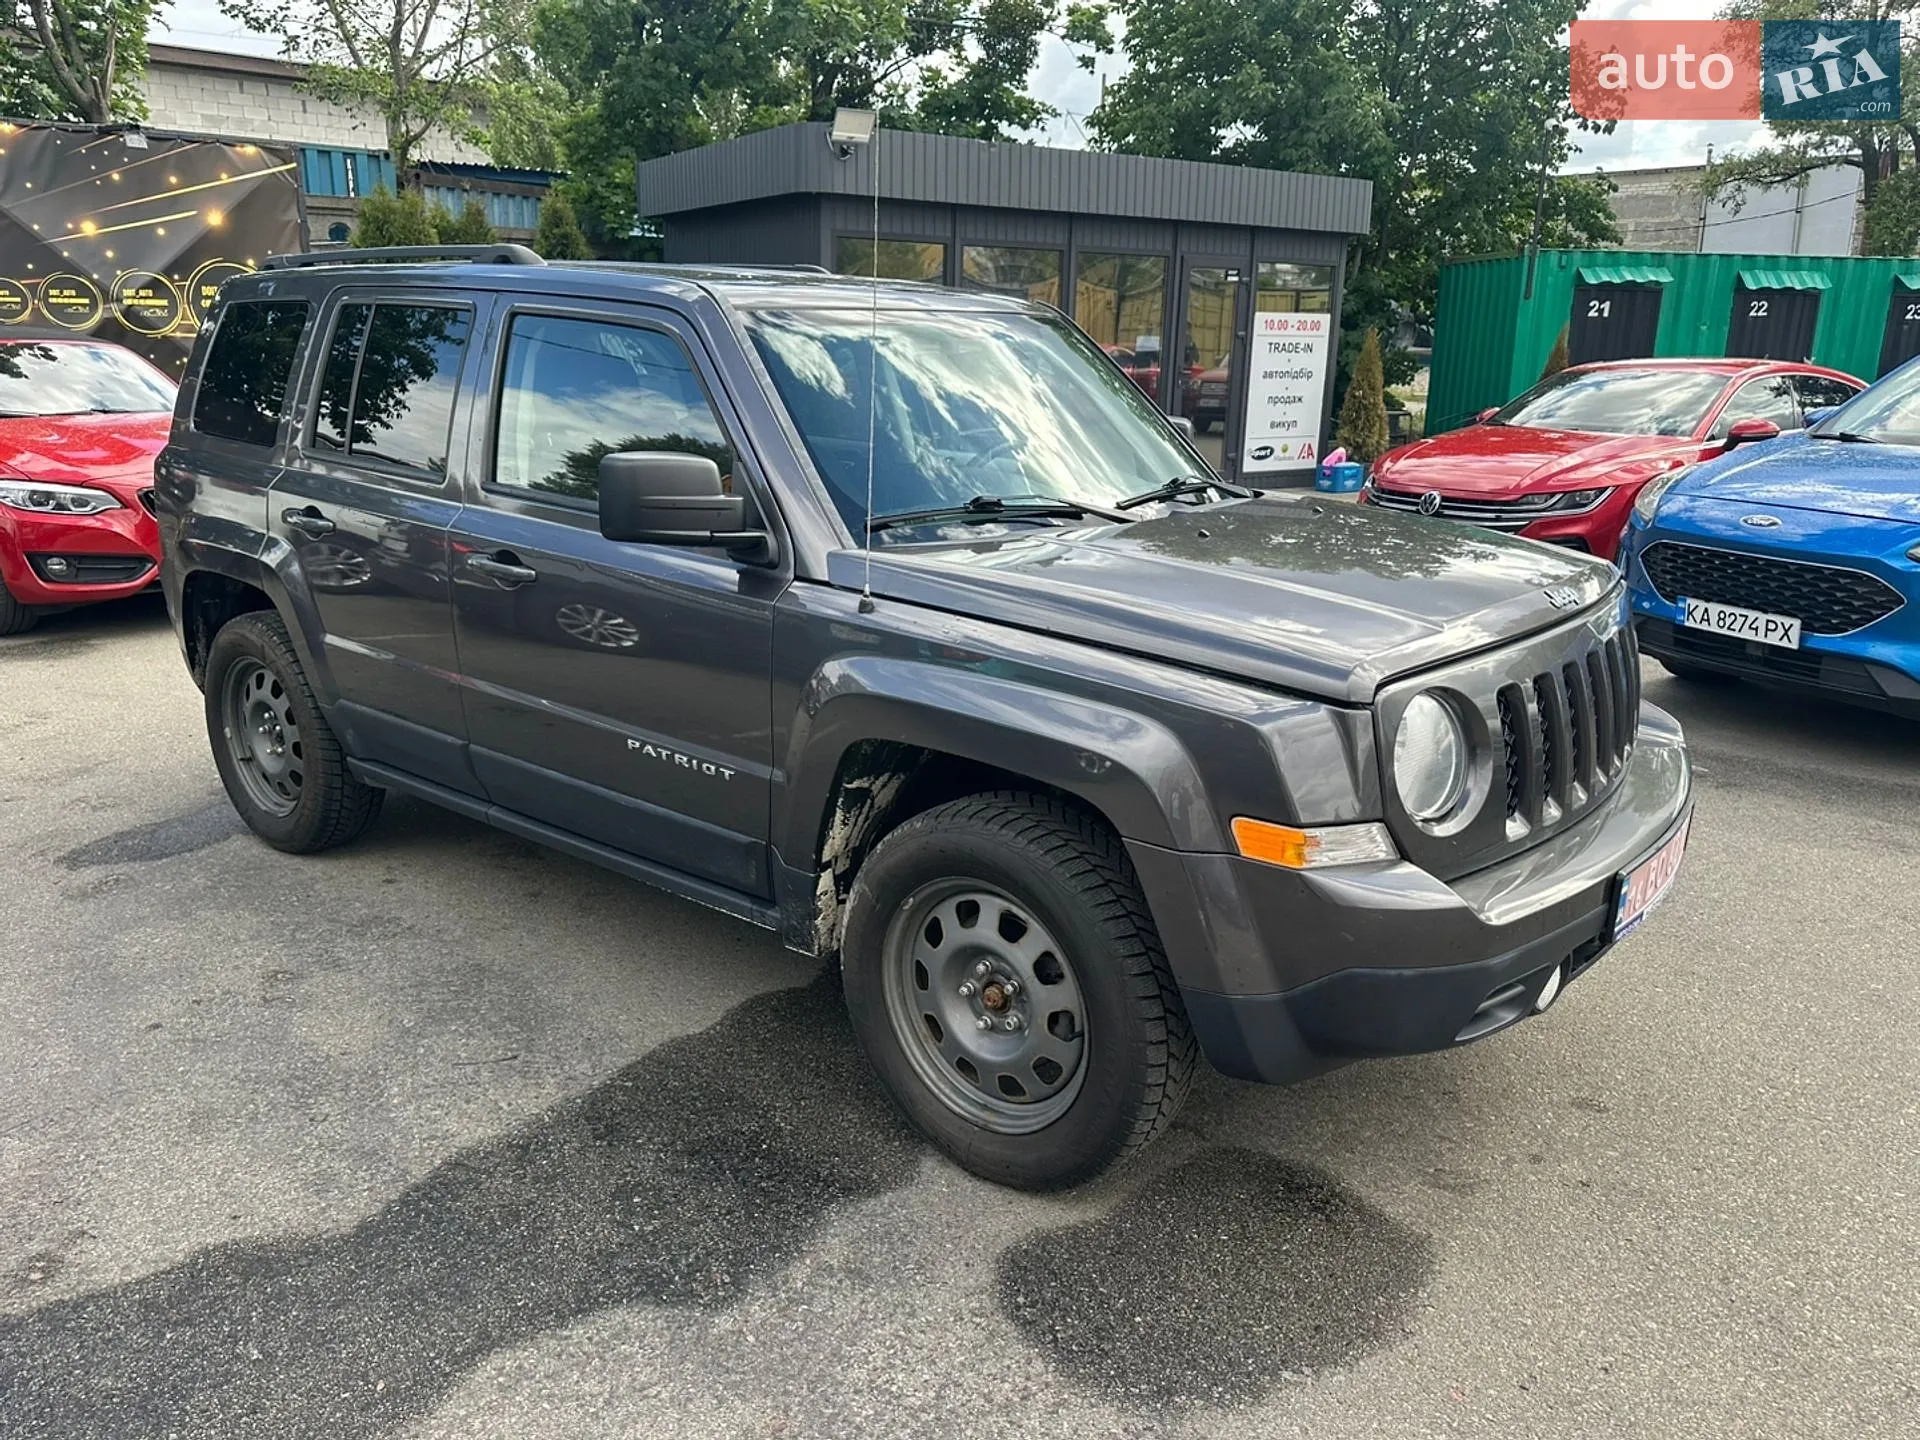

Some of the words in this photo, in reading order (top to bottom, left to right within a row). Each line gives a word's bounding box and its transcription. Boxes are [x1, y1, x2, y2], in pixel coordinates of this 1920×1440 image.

[1588, 300, 1612, 318] 21
[1749, 301, 1769, 317] 22
[1264, 319, 1289, 331] 10.00
[1296, 319, 1322, 331] 20.00
[1267, 342, 1314, 354] TRADE-IN
[1262, 367, 1314, 381] автопідбір
[1267, 395, 1304, 407] продаж
[1269, 419, 1298, 432] викуп
[1686, 603, 1711, 627] KA
[1716, 610, 1760, 637] 8274
[1763, 618, 1795, 644] PX
[626, 738, 736, 781] PATRIOT
